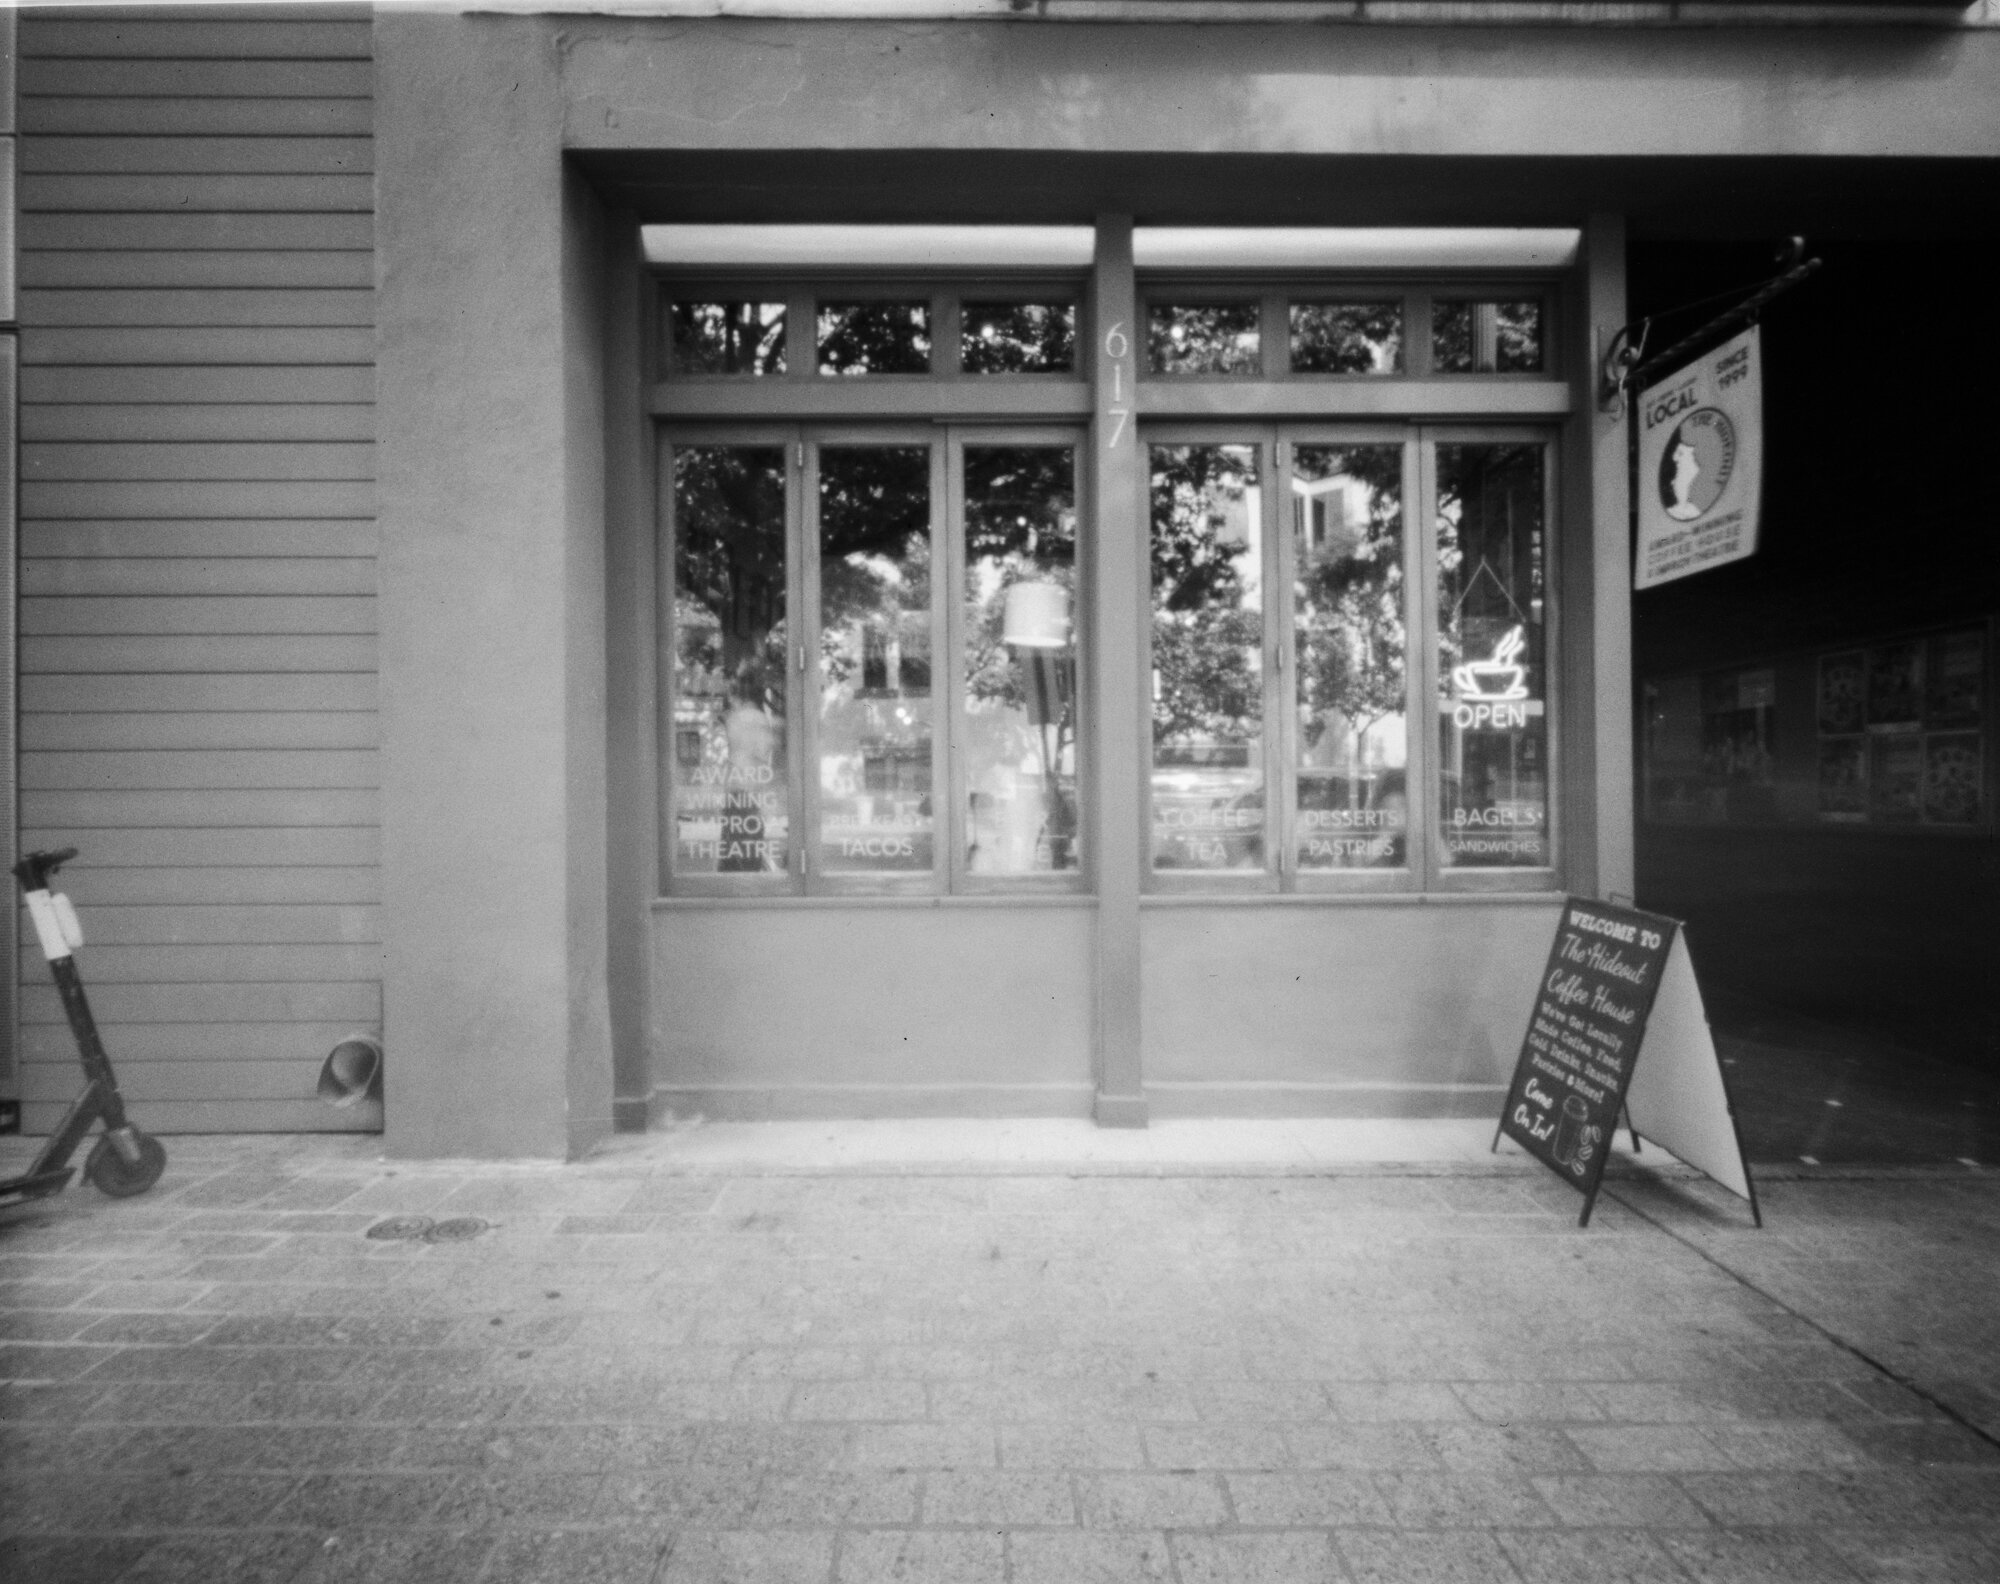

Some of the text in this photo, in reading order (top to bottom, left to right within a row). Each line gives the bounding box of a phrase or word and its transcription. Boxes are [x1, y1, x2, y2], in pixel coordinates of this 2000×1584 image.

[1715, 346, 1748, 374] SINCE
[1105, 321, 1128, 449] 617
[1718, 364, 1748, 389] 1999
[1646, 388, 1699, 430] LOCAL
[1454, 703, 1527, 729] OPEN
[691, 765, 773, 783] AWARD
[686, 792, 777, 809] WINNING
[1163, 808, 1248, 828] COFFEE
[1304, 809, 1397, 827] DESSERTS
[1454, 807, 1536, 826] BAGELS
[687, 840, 780, 859] THEATRE
[839, 838, 912, 856] TACOS
[1186, 841, 1228, 860] TEA
[1450, 840, 1540, 853] SANDWICHES
[1570, 911, 1662, 950] WELCOME TO
[1560, 933, 1648, 984] The Hideout
[1547, 968, 1636, 1024] Coffee House
[1525, 1078, 1553, 1110] Come
[1514, 1104, 1555, 1140] On In!
